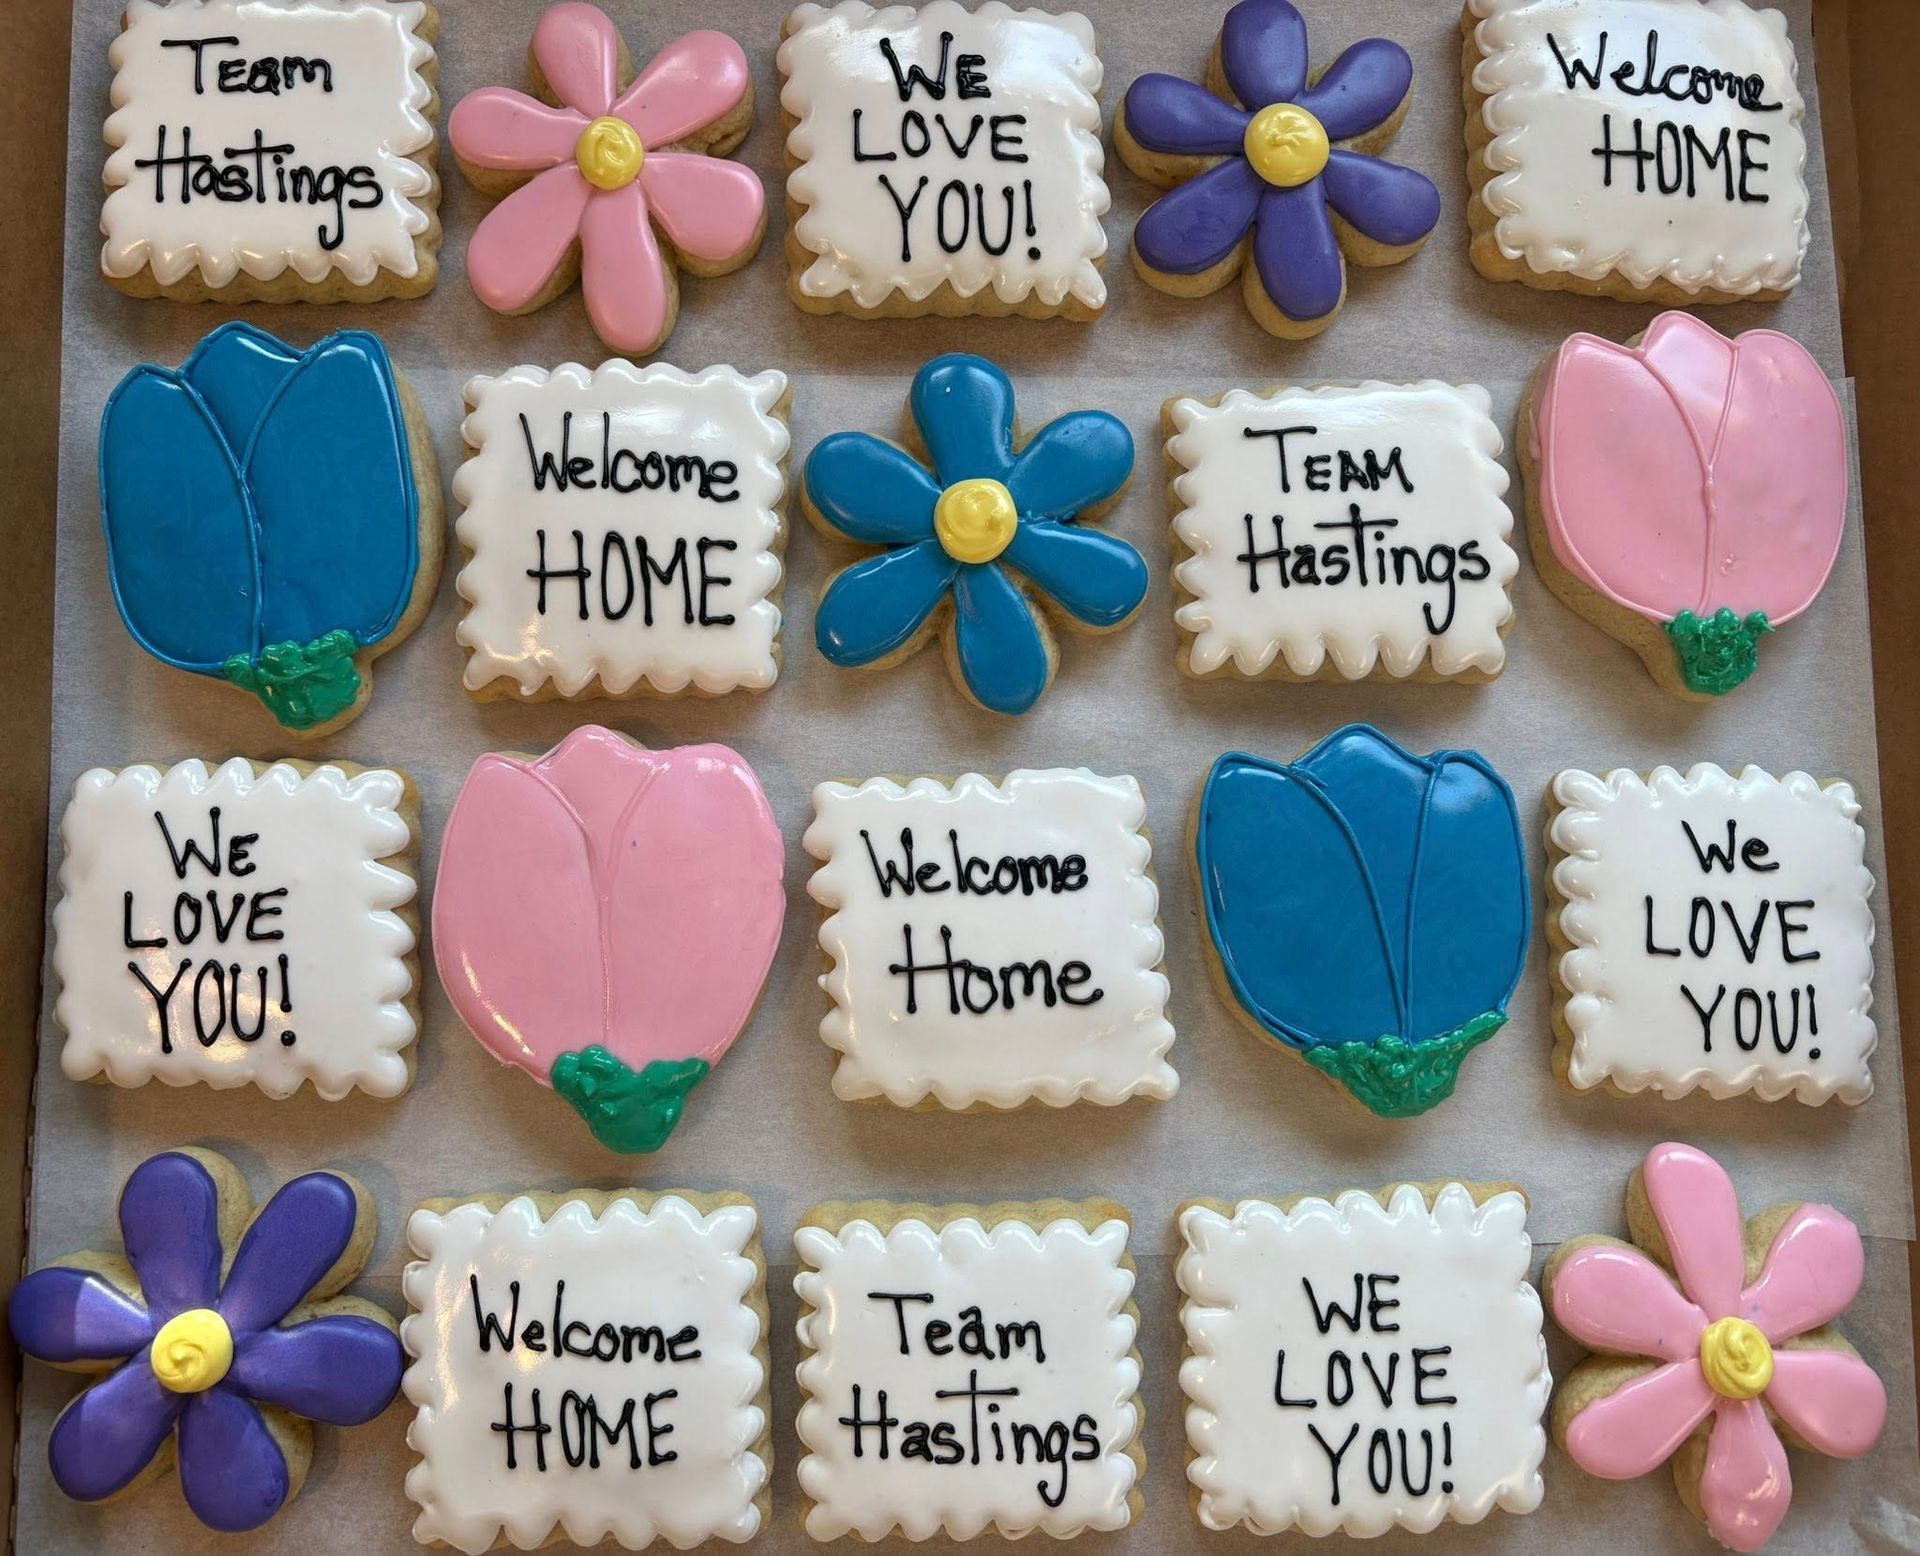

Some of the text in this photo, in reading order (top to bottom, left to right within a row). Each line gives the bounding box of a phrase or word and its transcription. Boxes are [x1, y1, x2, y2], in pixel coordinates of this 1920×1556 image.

[879, 30, 992, 103] WE
[1546, 29, 1784, 113] Welcome
[852, 108, 1029, 164] LOVE
[1591, 113, 1771, 204] HOME
[134, 124, 384, 252] Hastings
[878, 174, 1042, 263] YOU!
[518, 411, 740, 503] Welcome
[1243, 425, 1414, 494] TEAM
[526, 529, 738, 627] HOME
[1236, 502, 1491, 636] Hastings
[859, 827, 1089, 898] Welcome
[1681, 819, 1780, 874] We
[123, 887, 289, 955] LOVE
[1645, 895, 1821, 964] LOVE
[127, 953, 297, 1055] YOU!
[888, 923, 1104, 1015] Home
[1680, 983, 1821, 1060] YOU!
[469, 1274, 702, 1363] Welcome
[867, 1292, 1046, 1364] Team
[1302, 1273, 1400, 1335] WE
[1274, 1345, 1458, 1409] LOVE
[490, 1381, 678, 1473] HOME
[838, 1368, 1101, 1508] Hastings
[1307, 1421, 1454, 1506] YOU!
